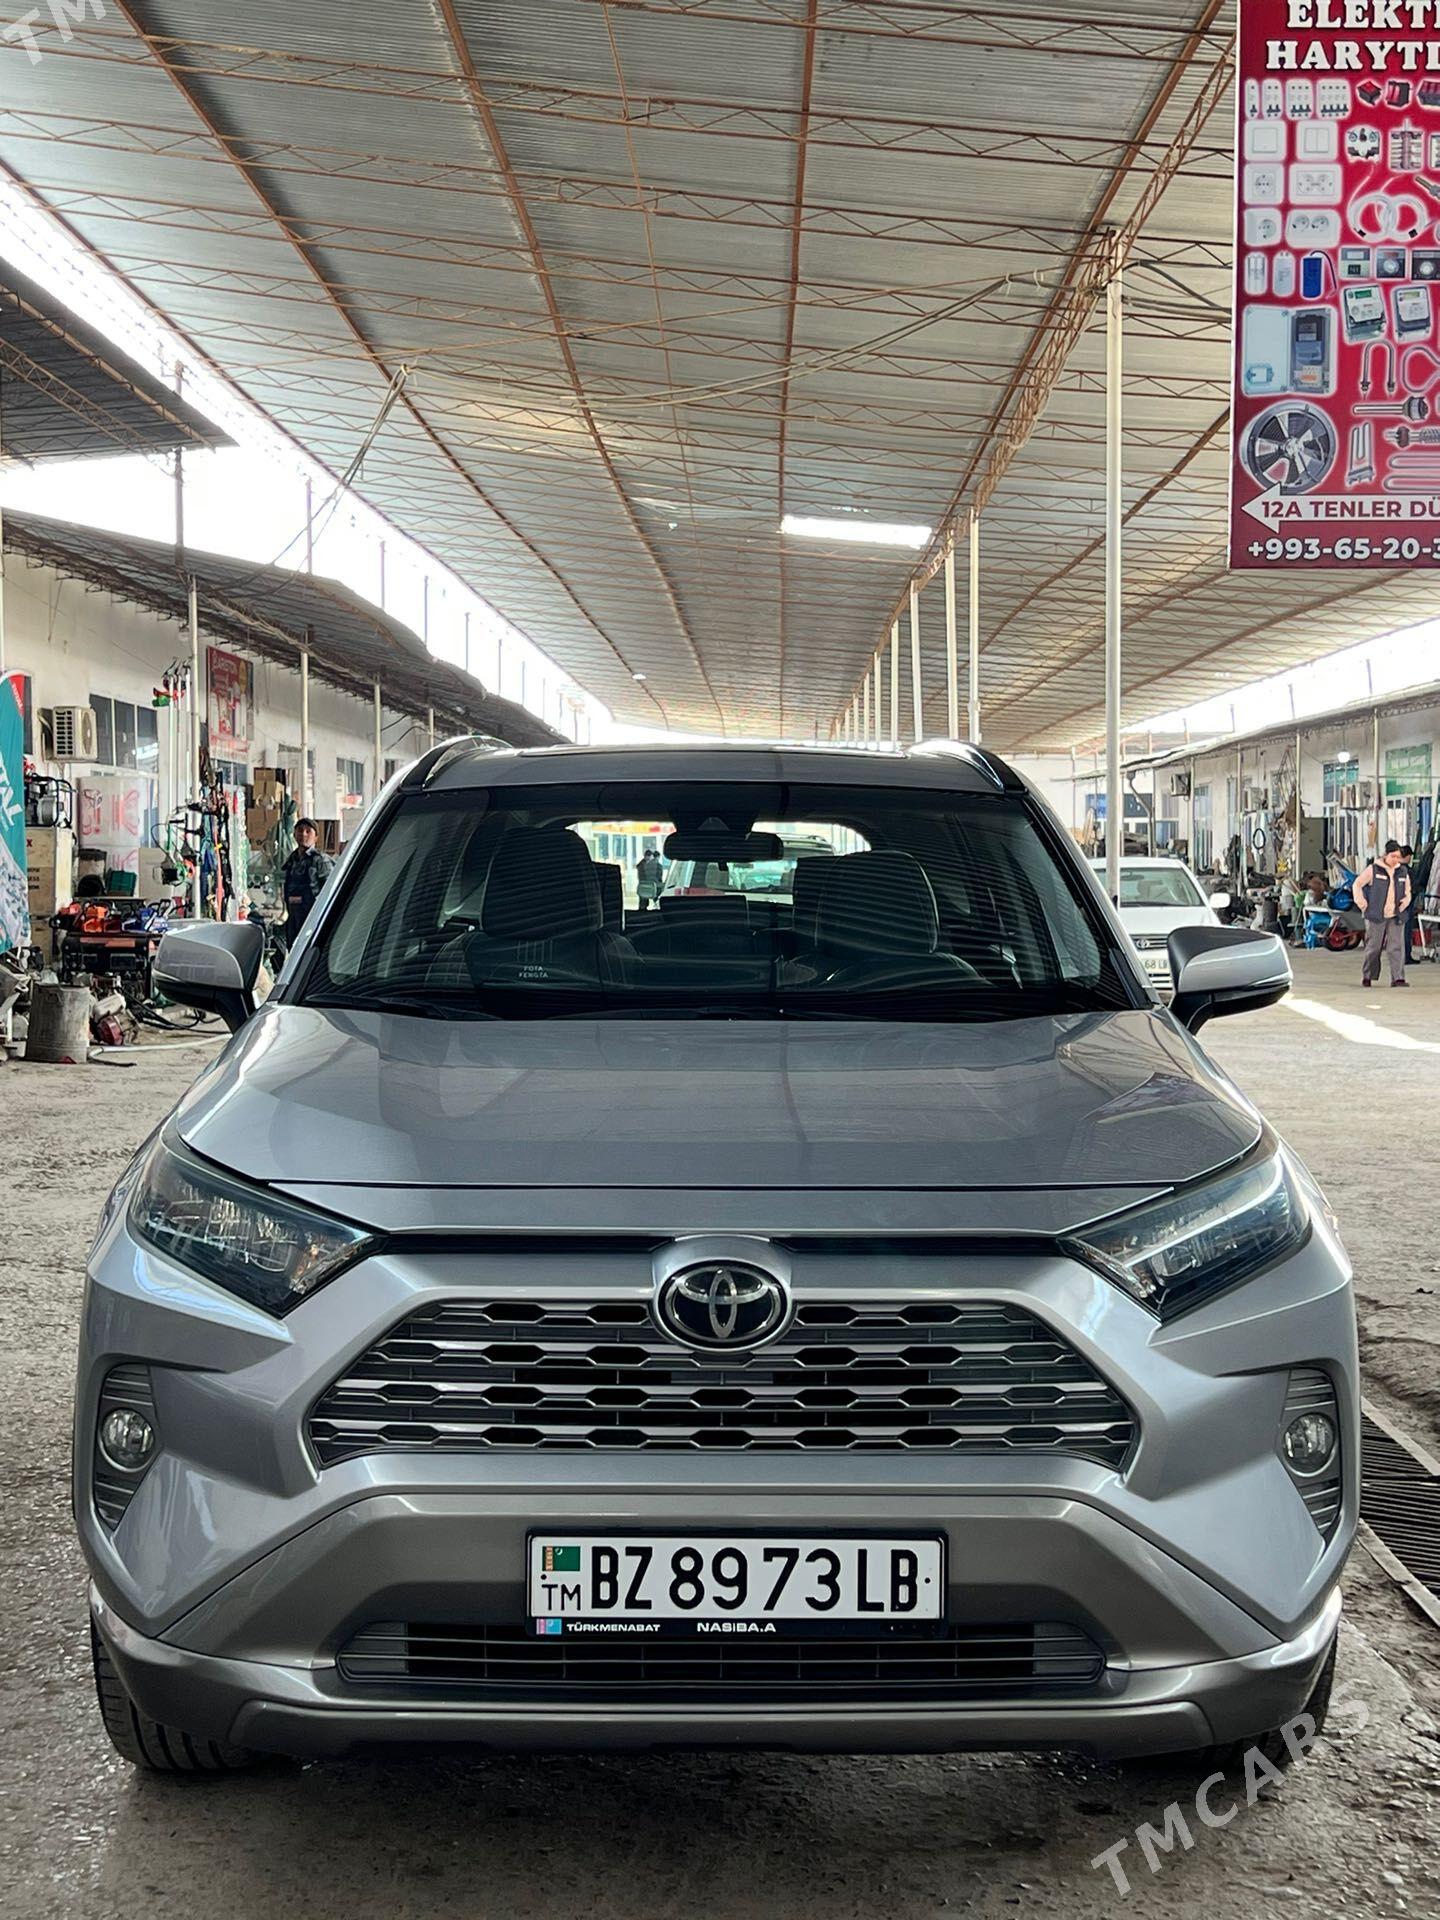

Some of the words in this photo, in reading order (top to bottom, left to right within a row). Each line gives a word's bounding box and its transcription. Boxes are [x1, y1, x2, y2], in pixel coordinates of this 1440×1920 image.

[1262, 502, 1302, 518] 12A
[1309, 502, 1402, 518] TENLER
[542, 1584, 581, 1611] TM
[566, 1622, 661, 1632] TÜRKMENABAT
[697, 1622, 777, 1633] NASIBA.A
